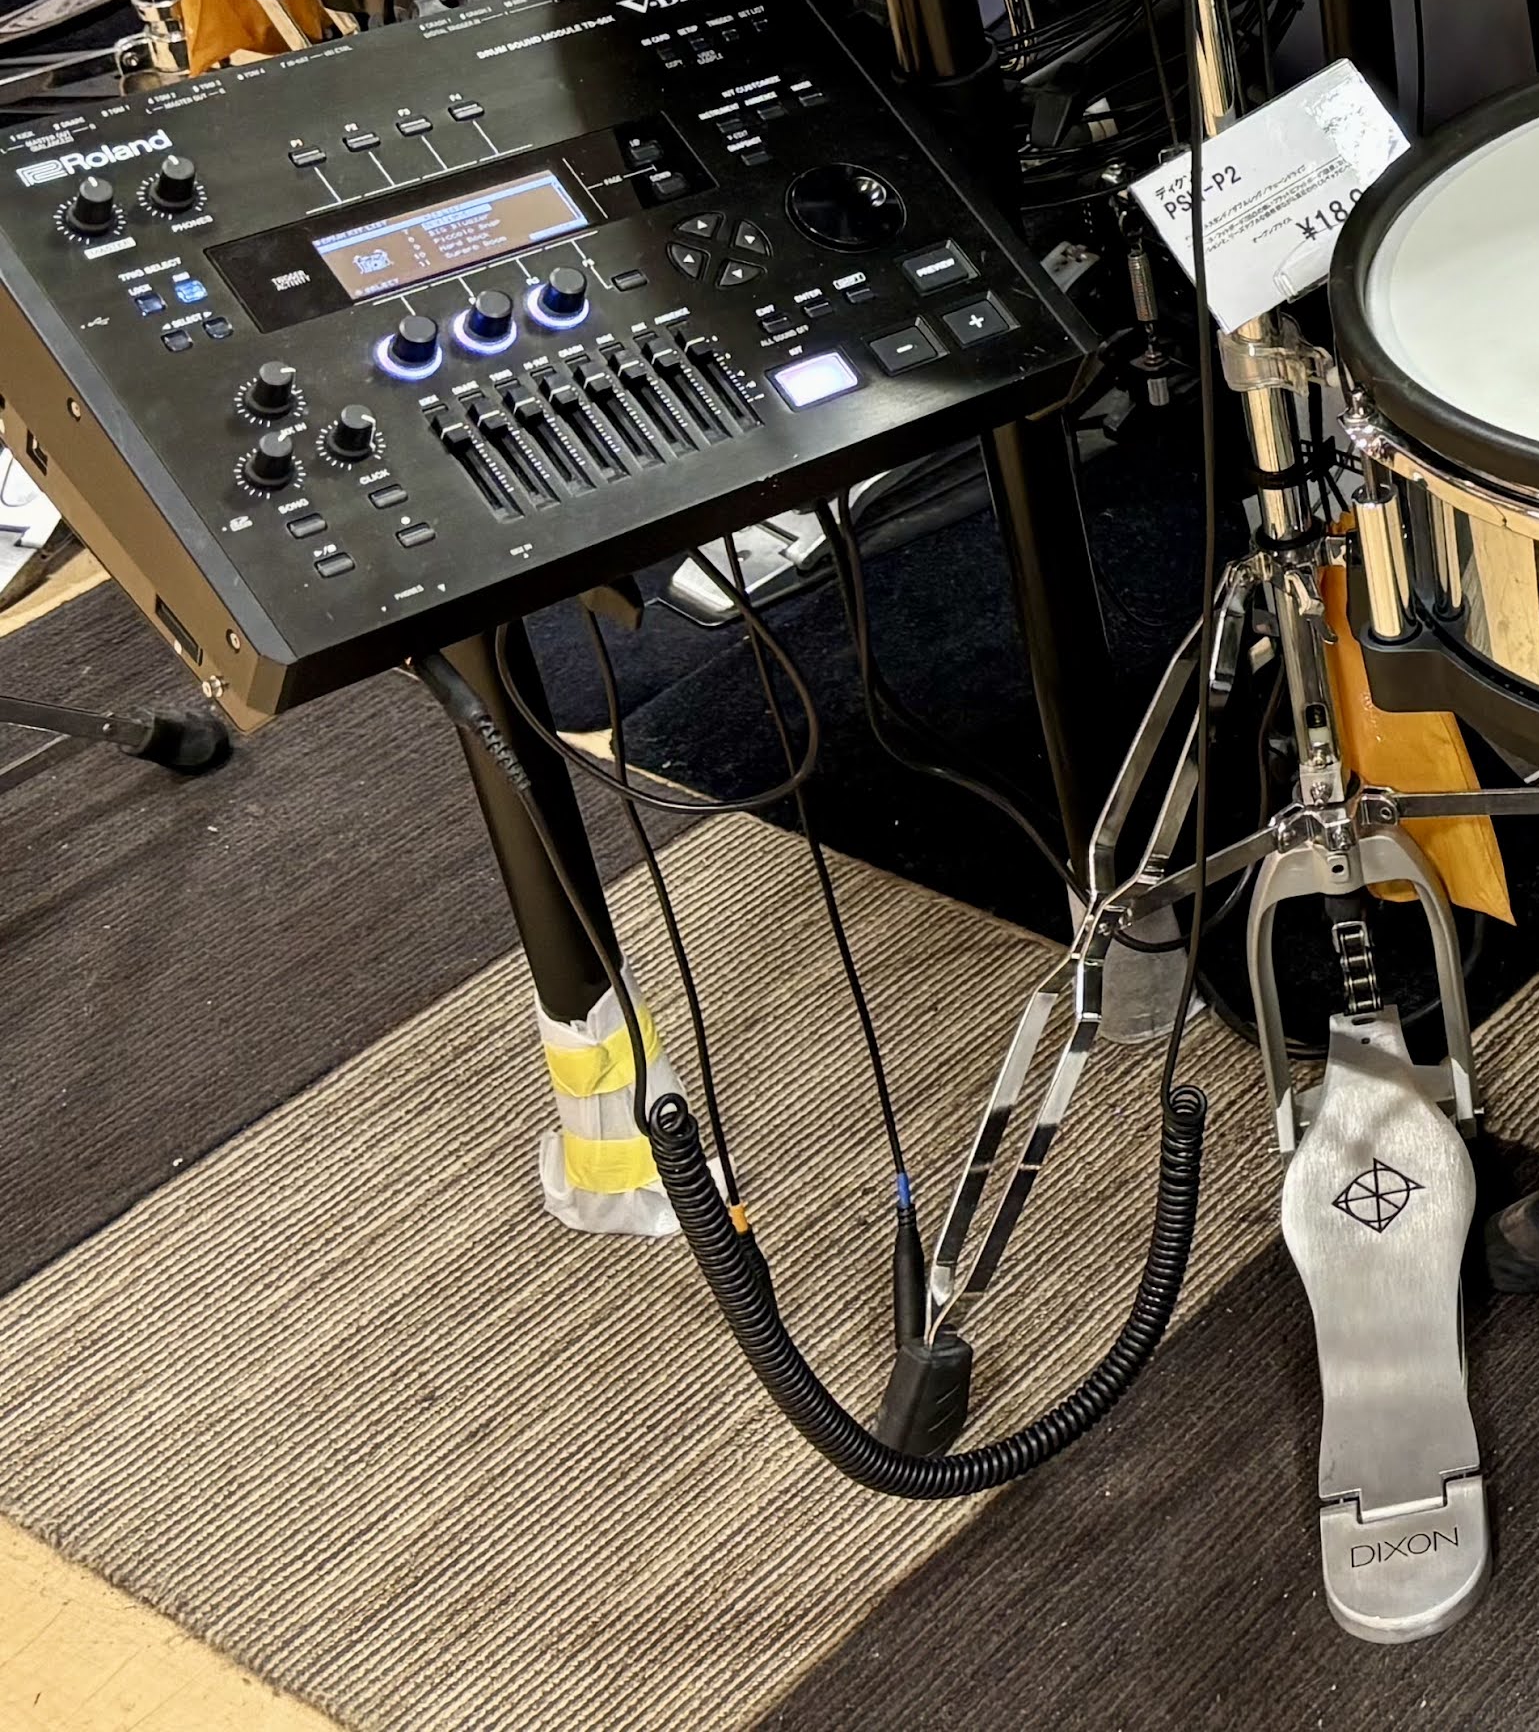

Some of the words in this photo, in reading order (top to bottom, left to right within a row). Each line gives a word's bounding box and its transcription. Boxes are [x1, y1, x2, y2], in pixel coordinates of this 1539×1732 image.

[60, 128, 173, 175] Roland
[358, 467, 391, 487] CLICK
[1351, 1527, 1459, 1568] DIXON
